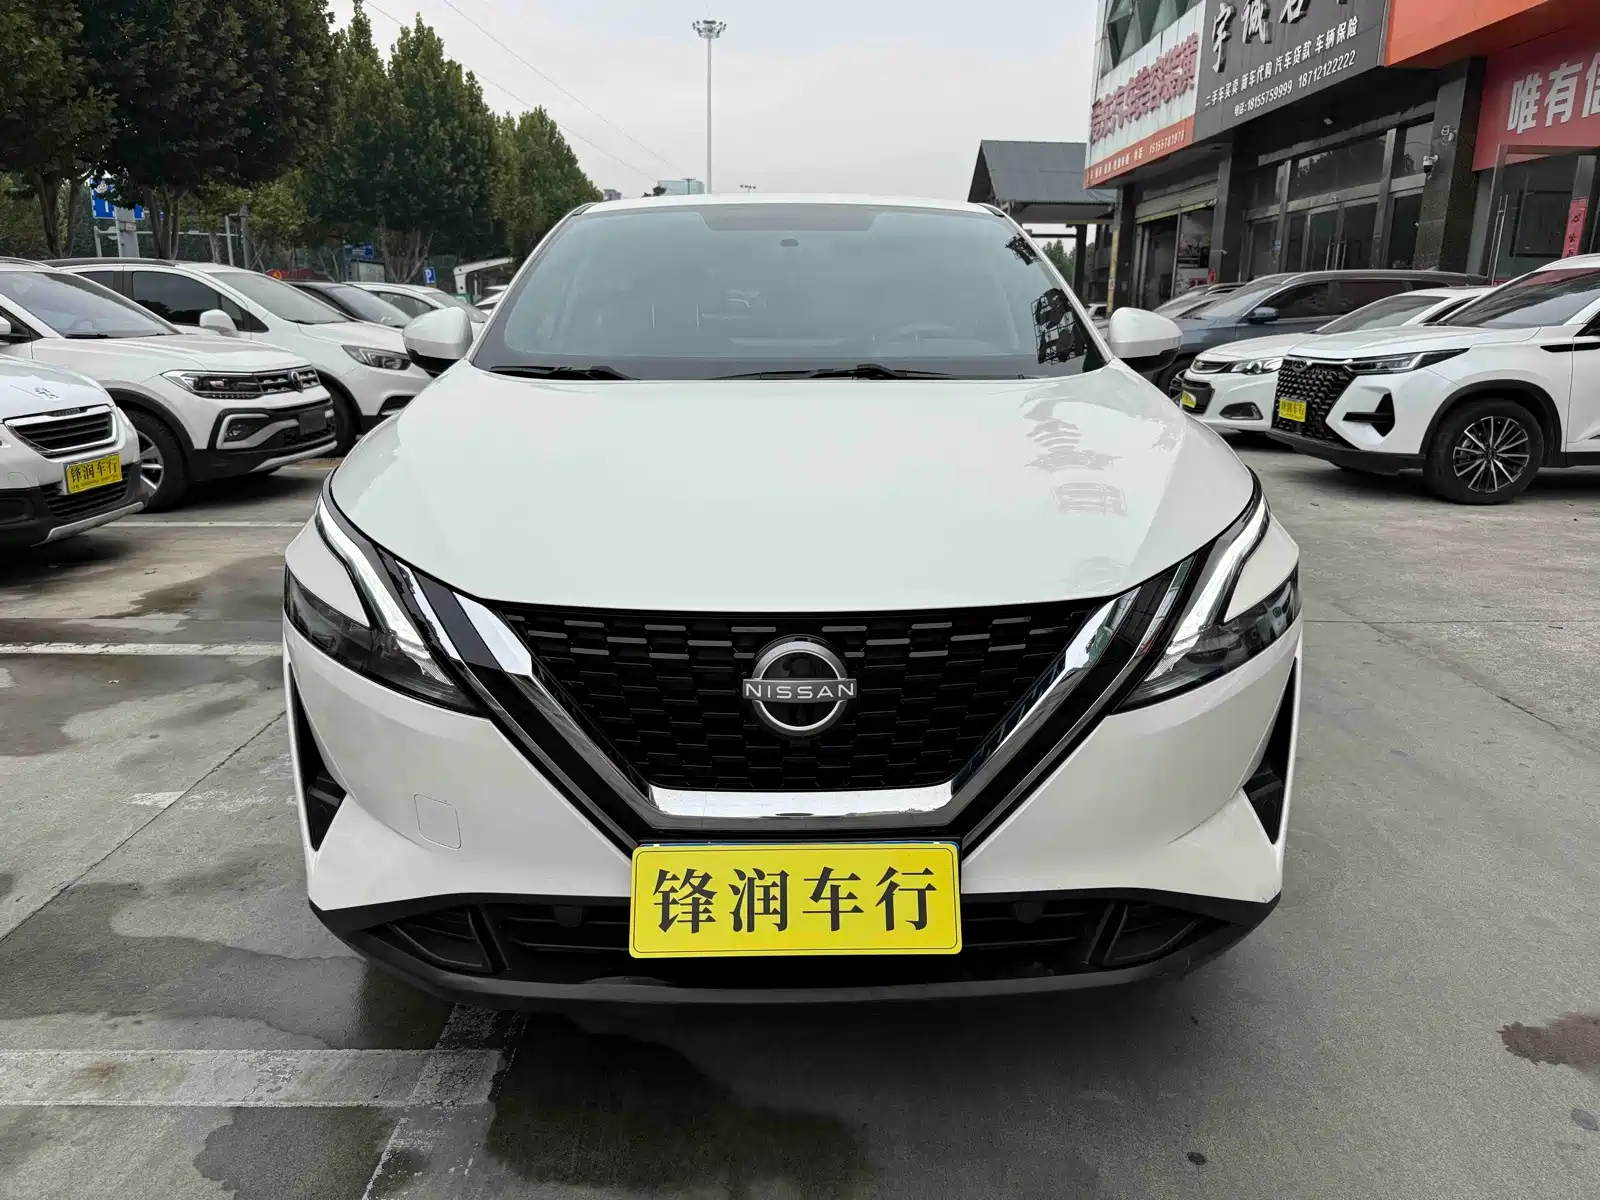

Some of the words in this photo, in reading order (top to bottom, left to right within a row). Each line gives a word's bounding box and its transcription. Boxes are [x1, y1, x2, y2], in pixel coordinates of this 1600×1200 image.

[1205, 78, 1239, 107] 二手车买卖
[1241, 61, 1273, 91] 新车代购
[1274, 40, 1313, 75] 汽车贷款
[1315, 15, 1359, 54] 车辆保险
[1298, 50, 1356, 89] 18712122222
[745, 682, 854, 699] NISSAN
[652, 865, 938, 935] 锋润车行
